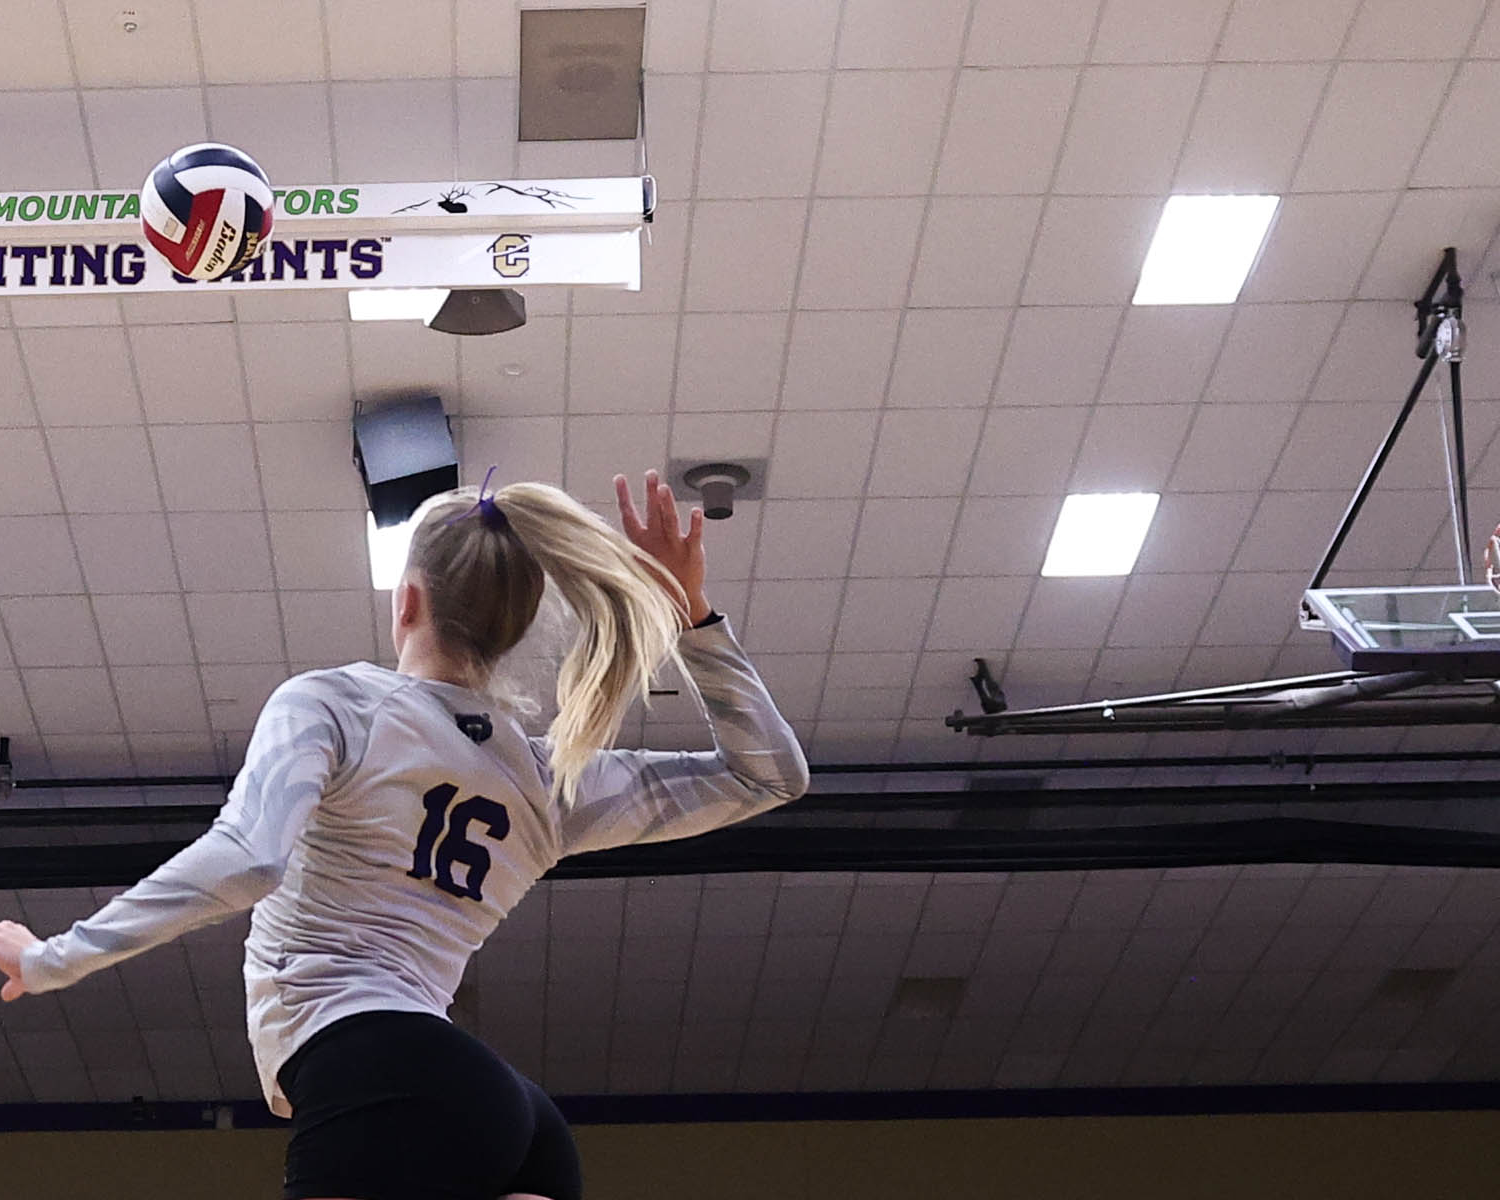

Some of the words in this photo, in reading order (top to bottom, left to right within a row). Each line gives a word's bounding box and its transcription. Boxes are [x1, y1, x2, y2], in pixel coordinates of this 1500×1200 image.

[272, 188, 360, 215] TORS
[172, 238, 383, 284] INTS
[406, 782, 511, 902] 16
